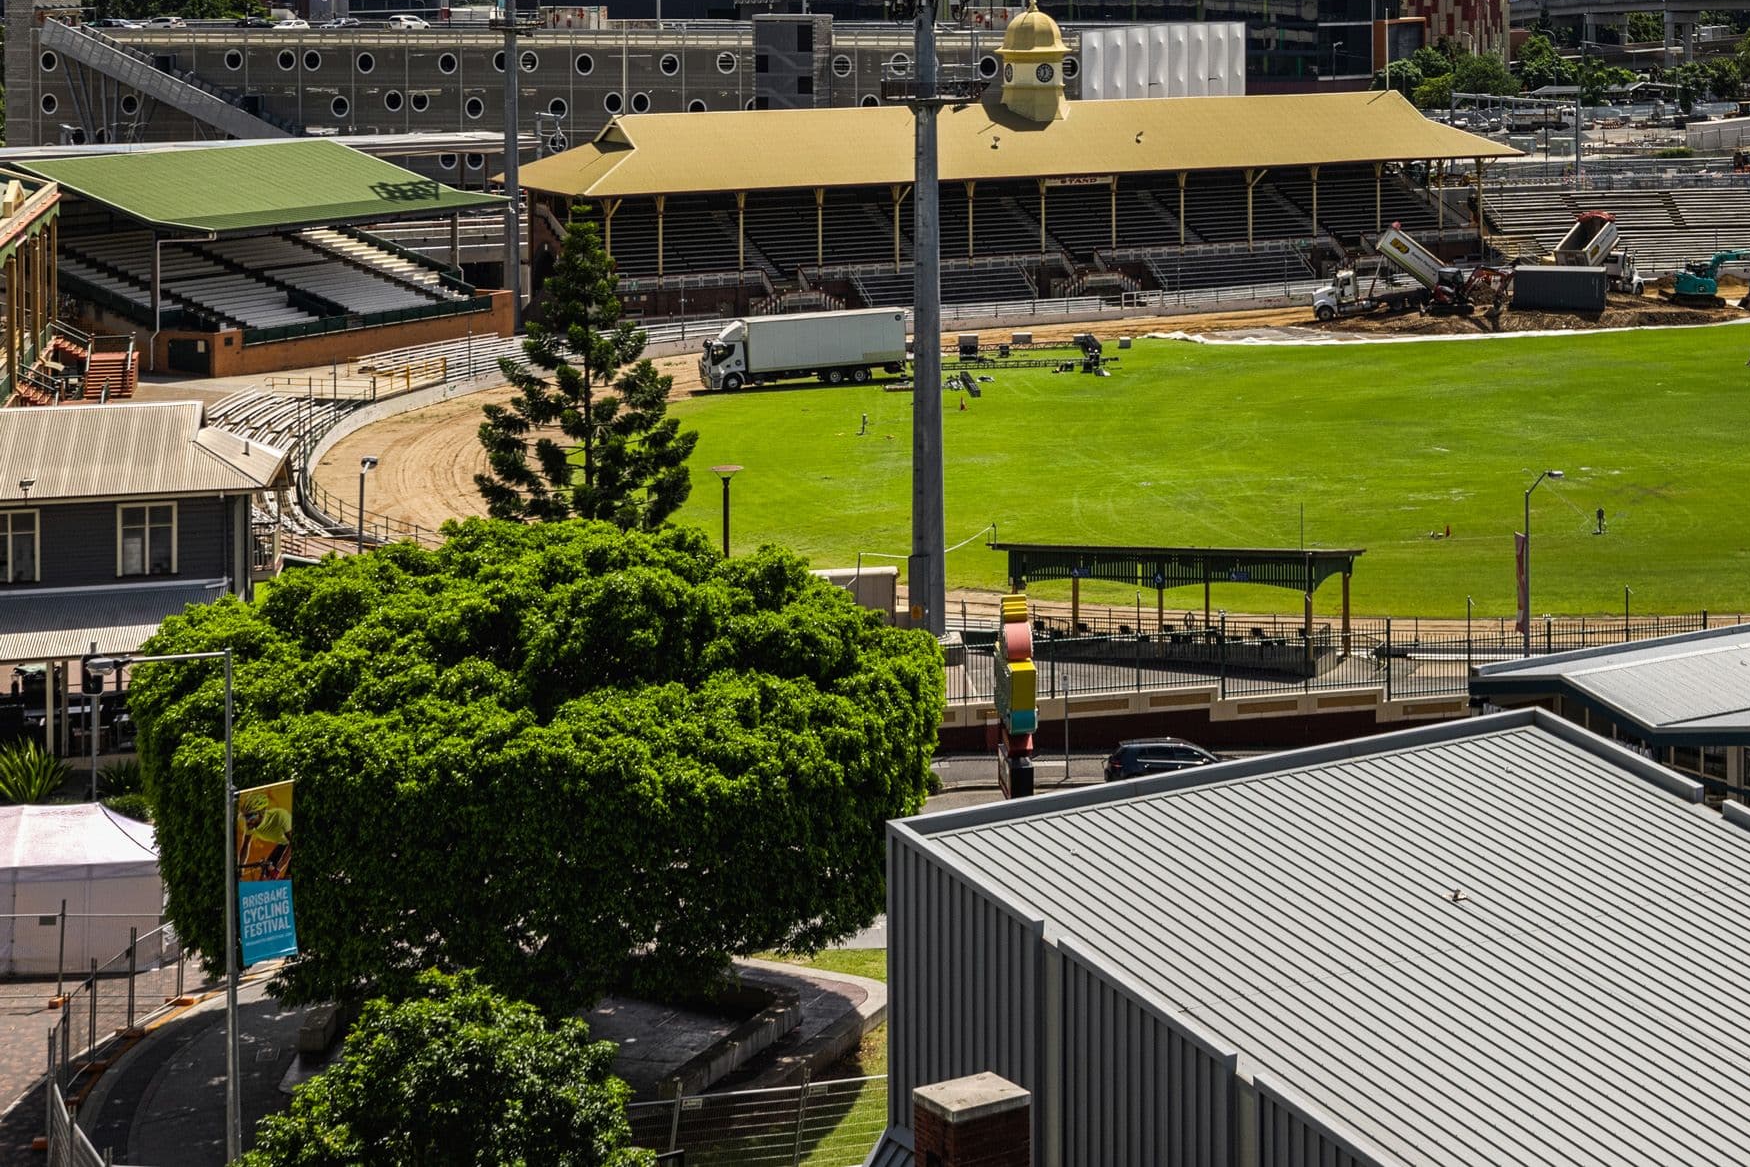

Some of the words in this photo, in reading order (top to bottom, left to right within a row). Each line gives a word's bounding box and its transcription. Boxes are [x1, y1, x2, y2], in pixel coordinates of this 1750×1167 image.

[242, 886, 289, 909] BRISBANE
[243, 900, 290, 924] CYCLING
[244, 916, 291, 939] FESTIVAL
